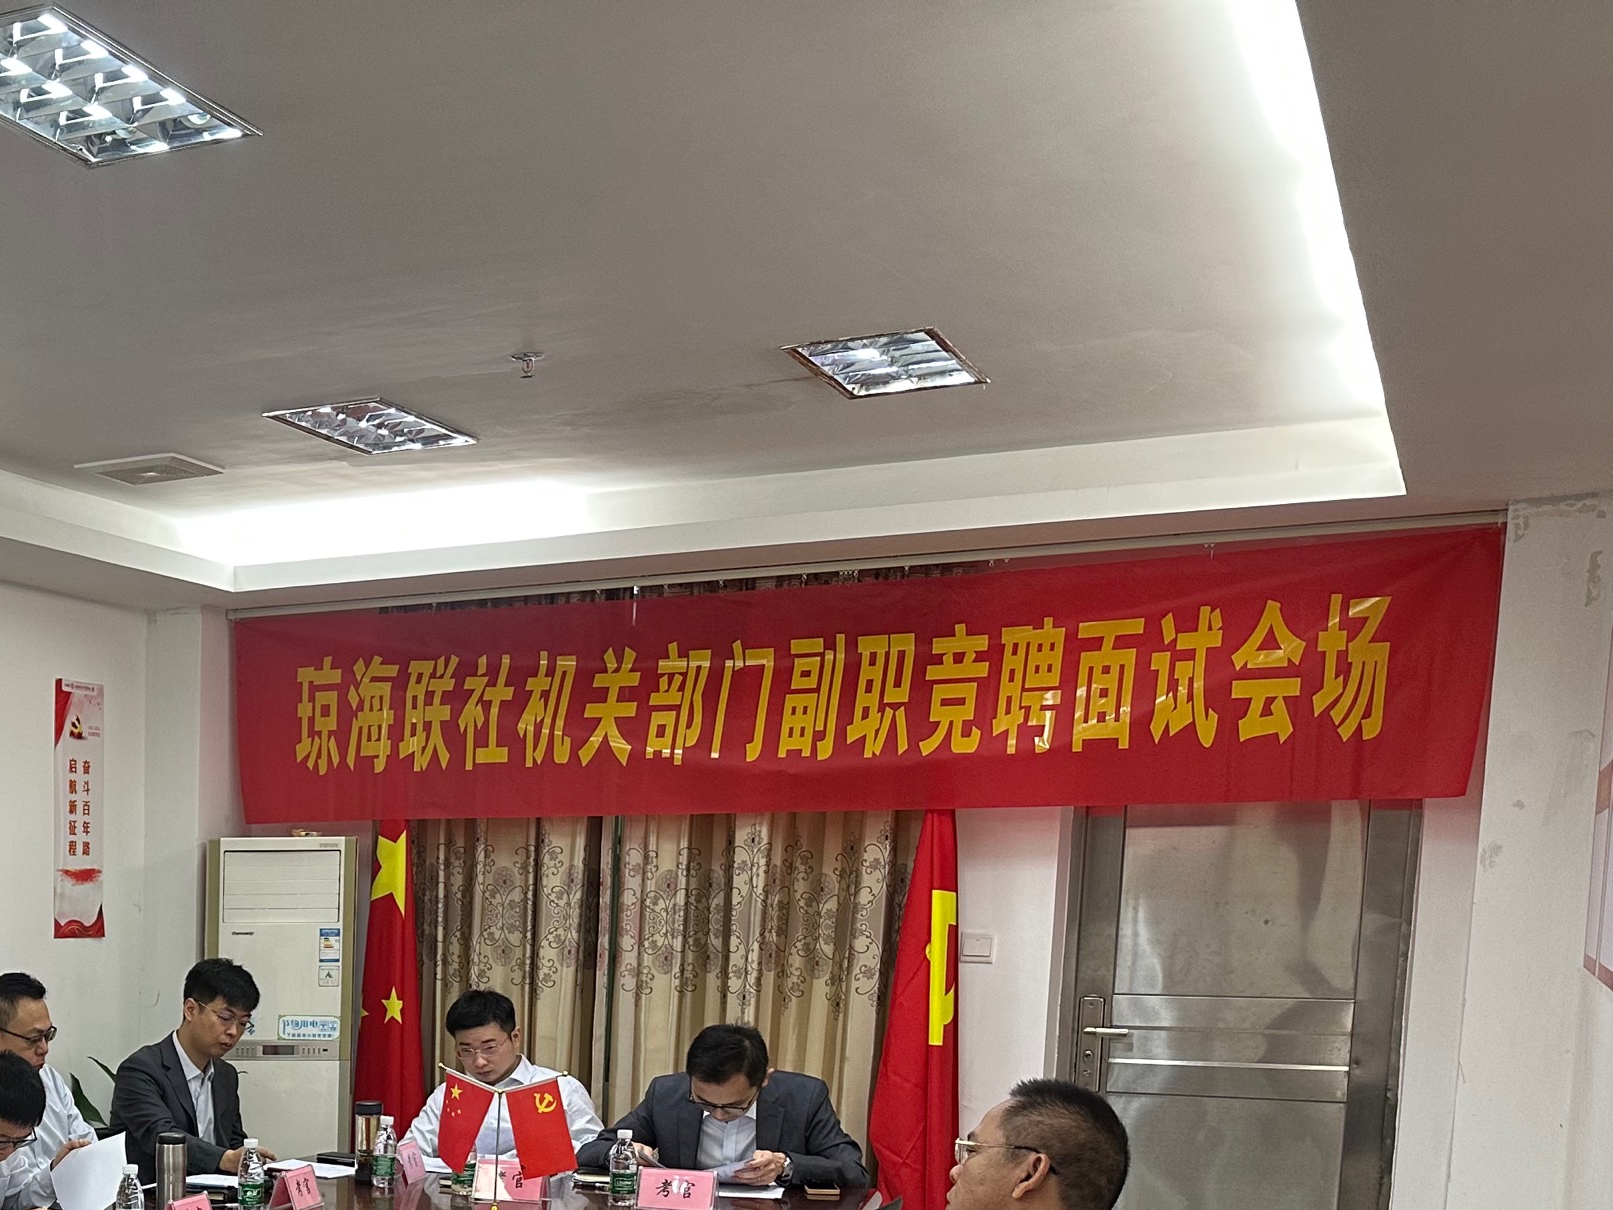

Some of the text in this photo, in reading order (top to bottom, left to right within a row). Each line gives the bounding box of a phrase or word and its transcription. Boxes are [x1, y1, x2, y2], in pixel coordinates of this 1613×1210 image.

[294, 594, 1392, 776] 琼海联社机关部门副职竞聘面试会场
